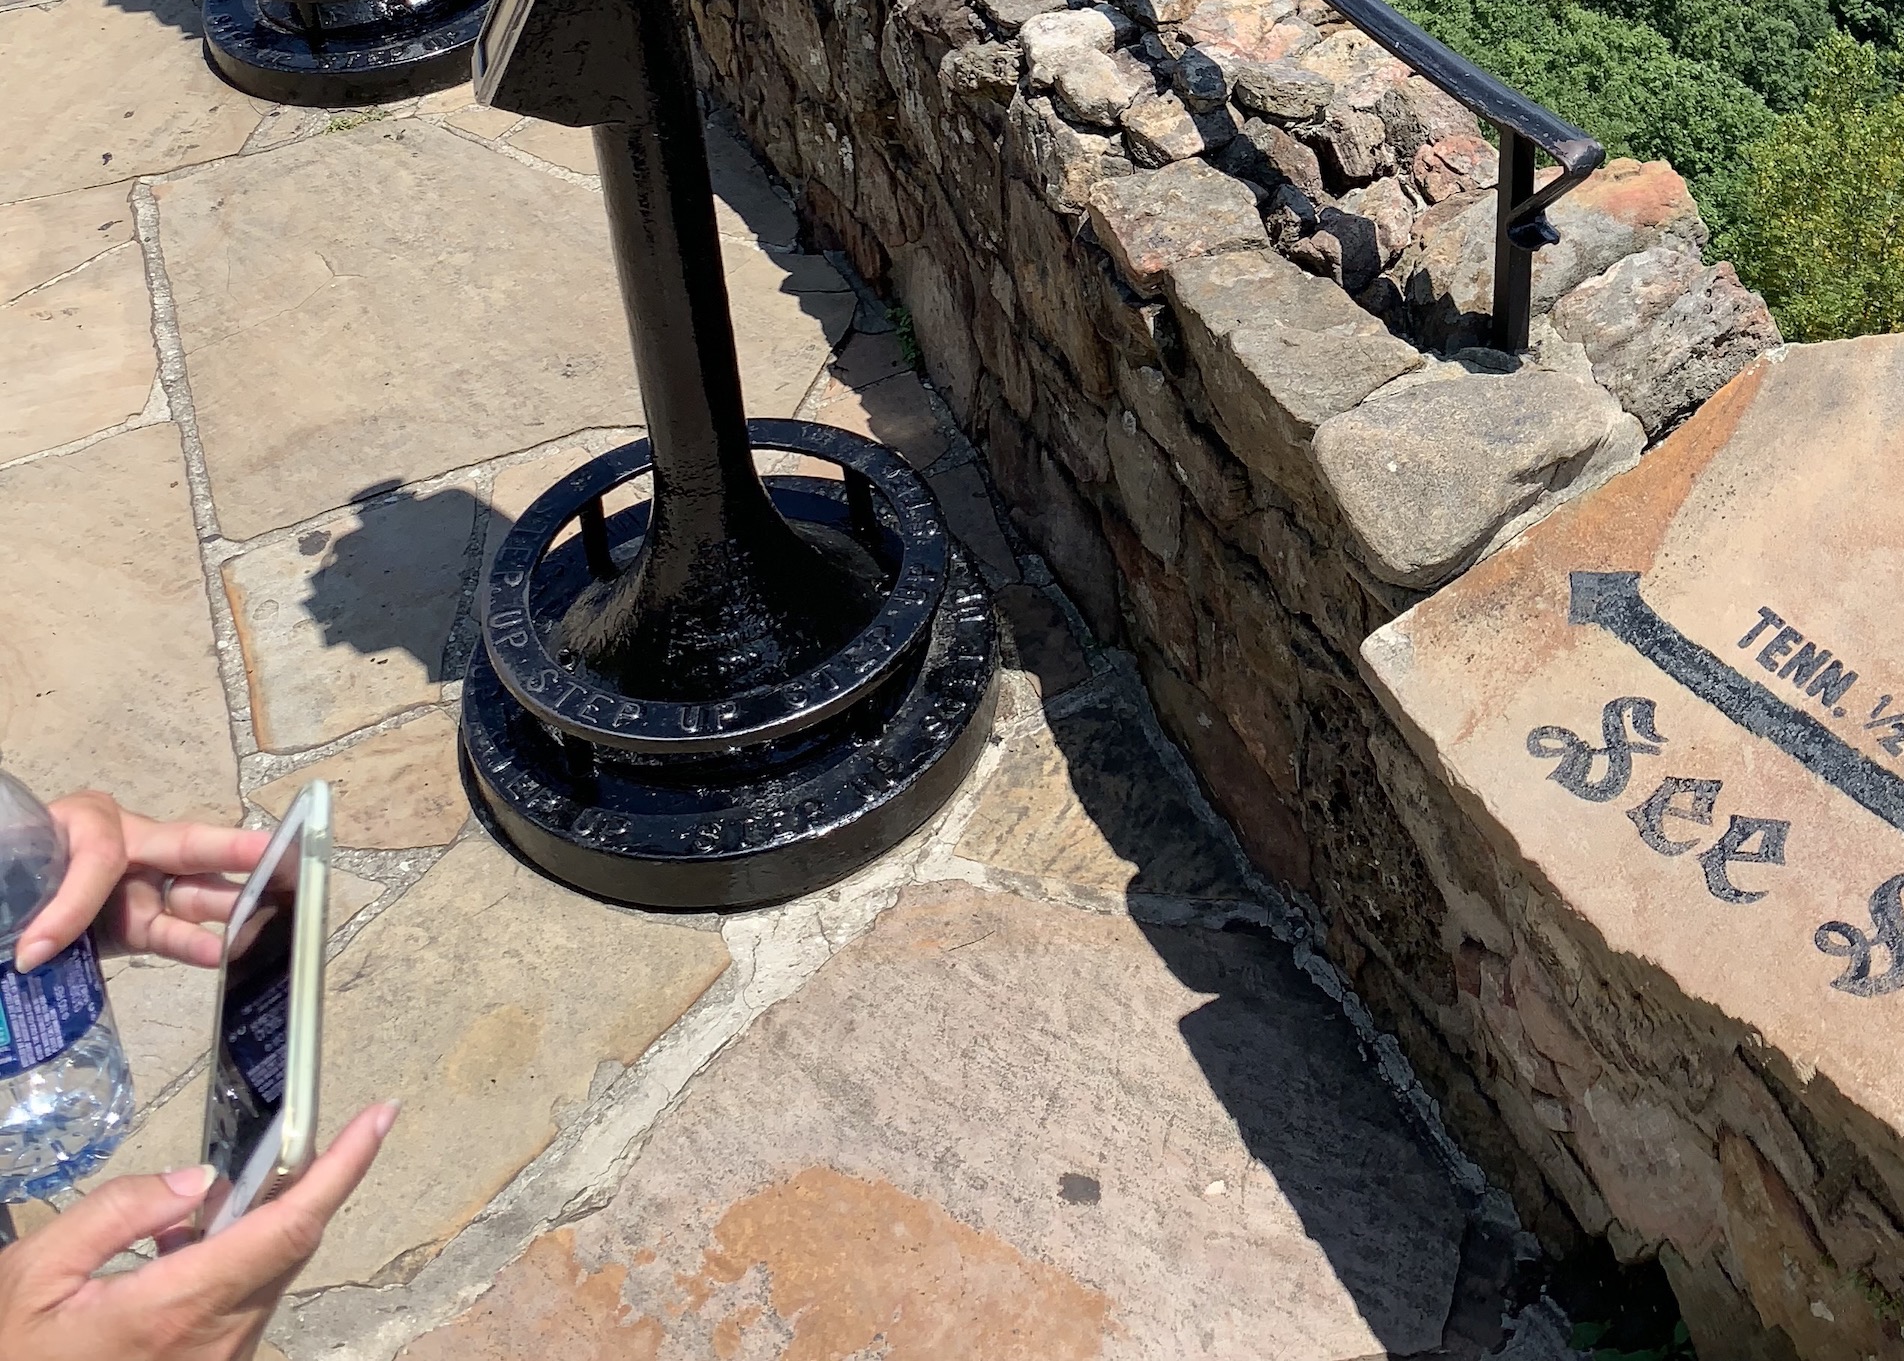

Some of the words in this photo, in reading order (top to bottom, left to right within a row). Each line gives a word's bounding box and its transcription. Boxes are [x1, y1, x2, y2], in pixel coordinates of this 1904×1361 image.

[488, 608, 530, 648] UP
[1736, 606, 1859, 719] TENN.
[526, 667, 646, 730] STEP
[678, 700, 739, 735] UP
[1526, 696, 1791, 905] See
